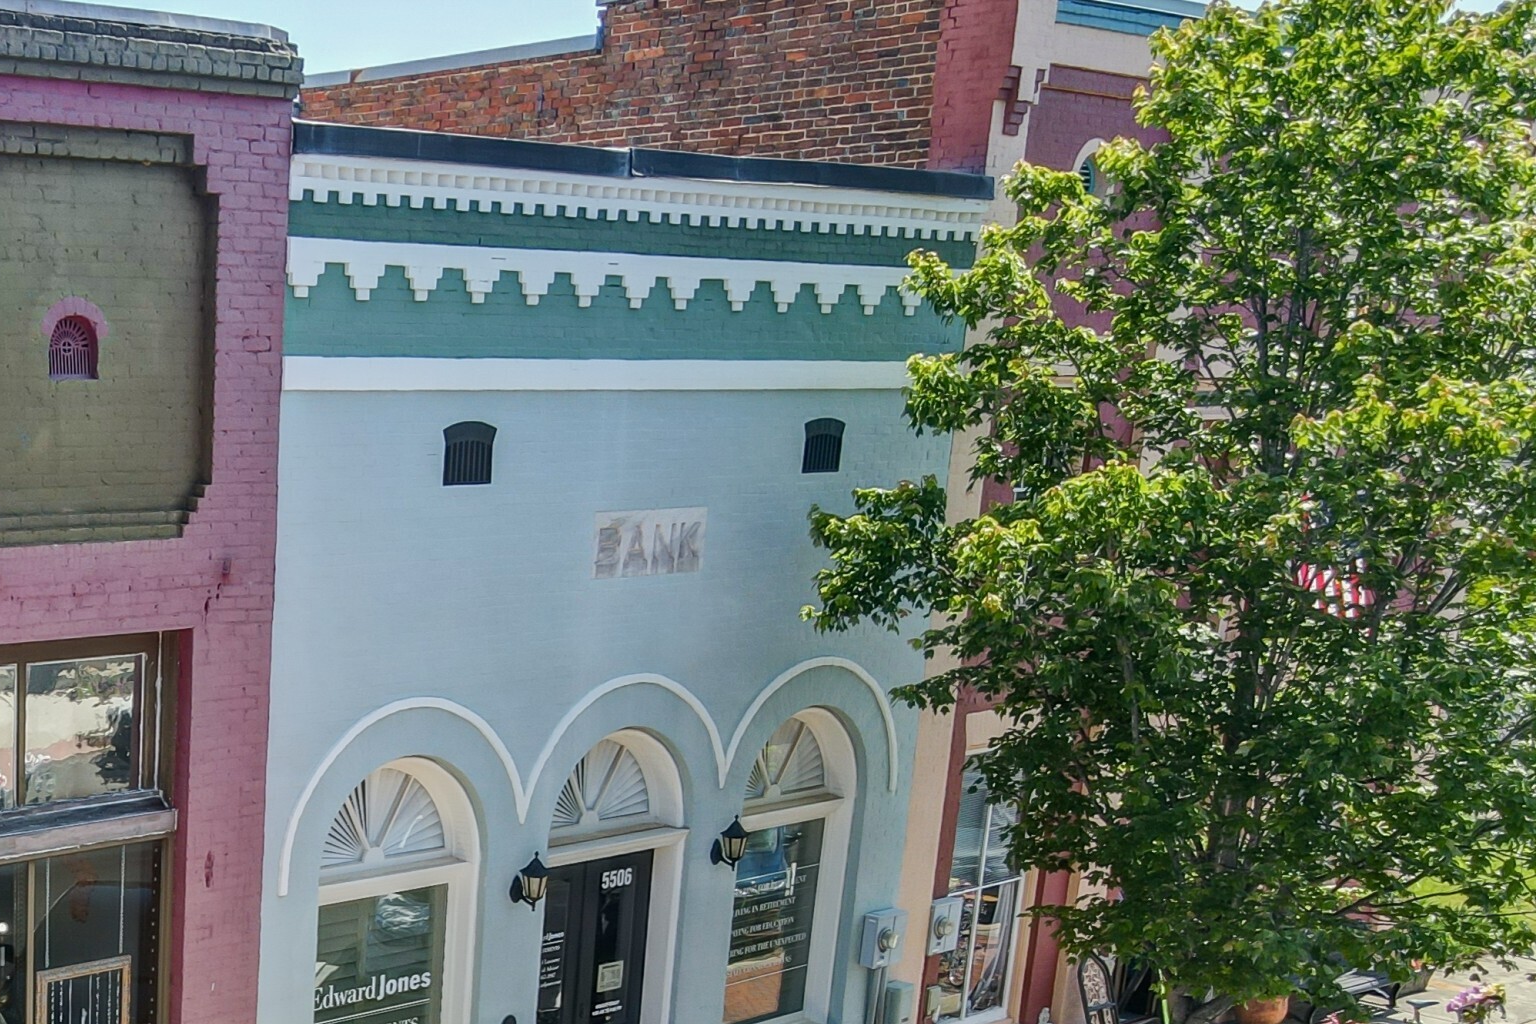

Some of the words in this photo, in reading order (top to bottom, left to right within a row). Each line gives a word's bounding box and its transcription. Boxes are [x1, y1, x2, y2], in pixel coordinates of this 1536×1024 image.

[594, 521, 701, 578] BANK
[601, 868, 633, 890] 5506
[314, 976, 376, 1012] Edward
[376, 971, 431, 1001] Jones
